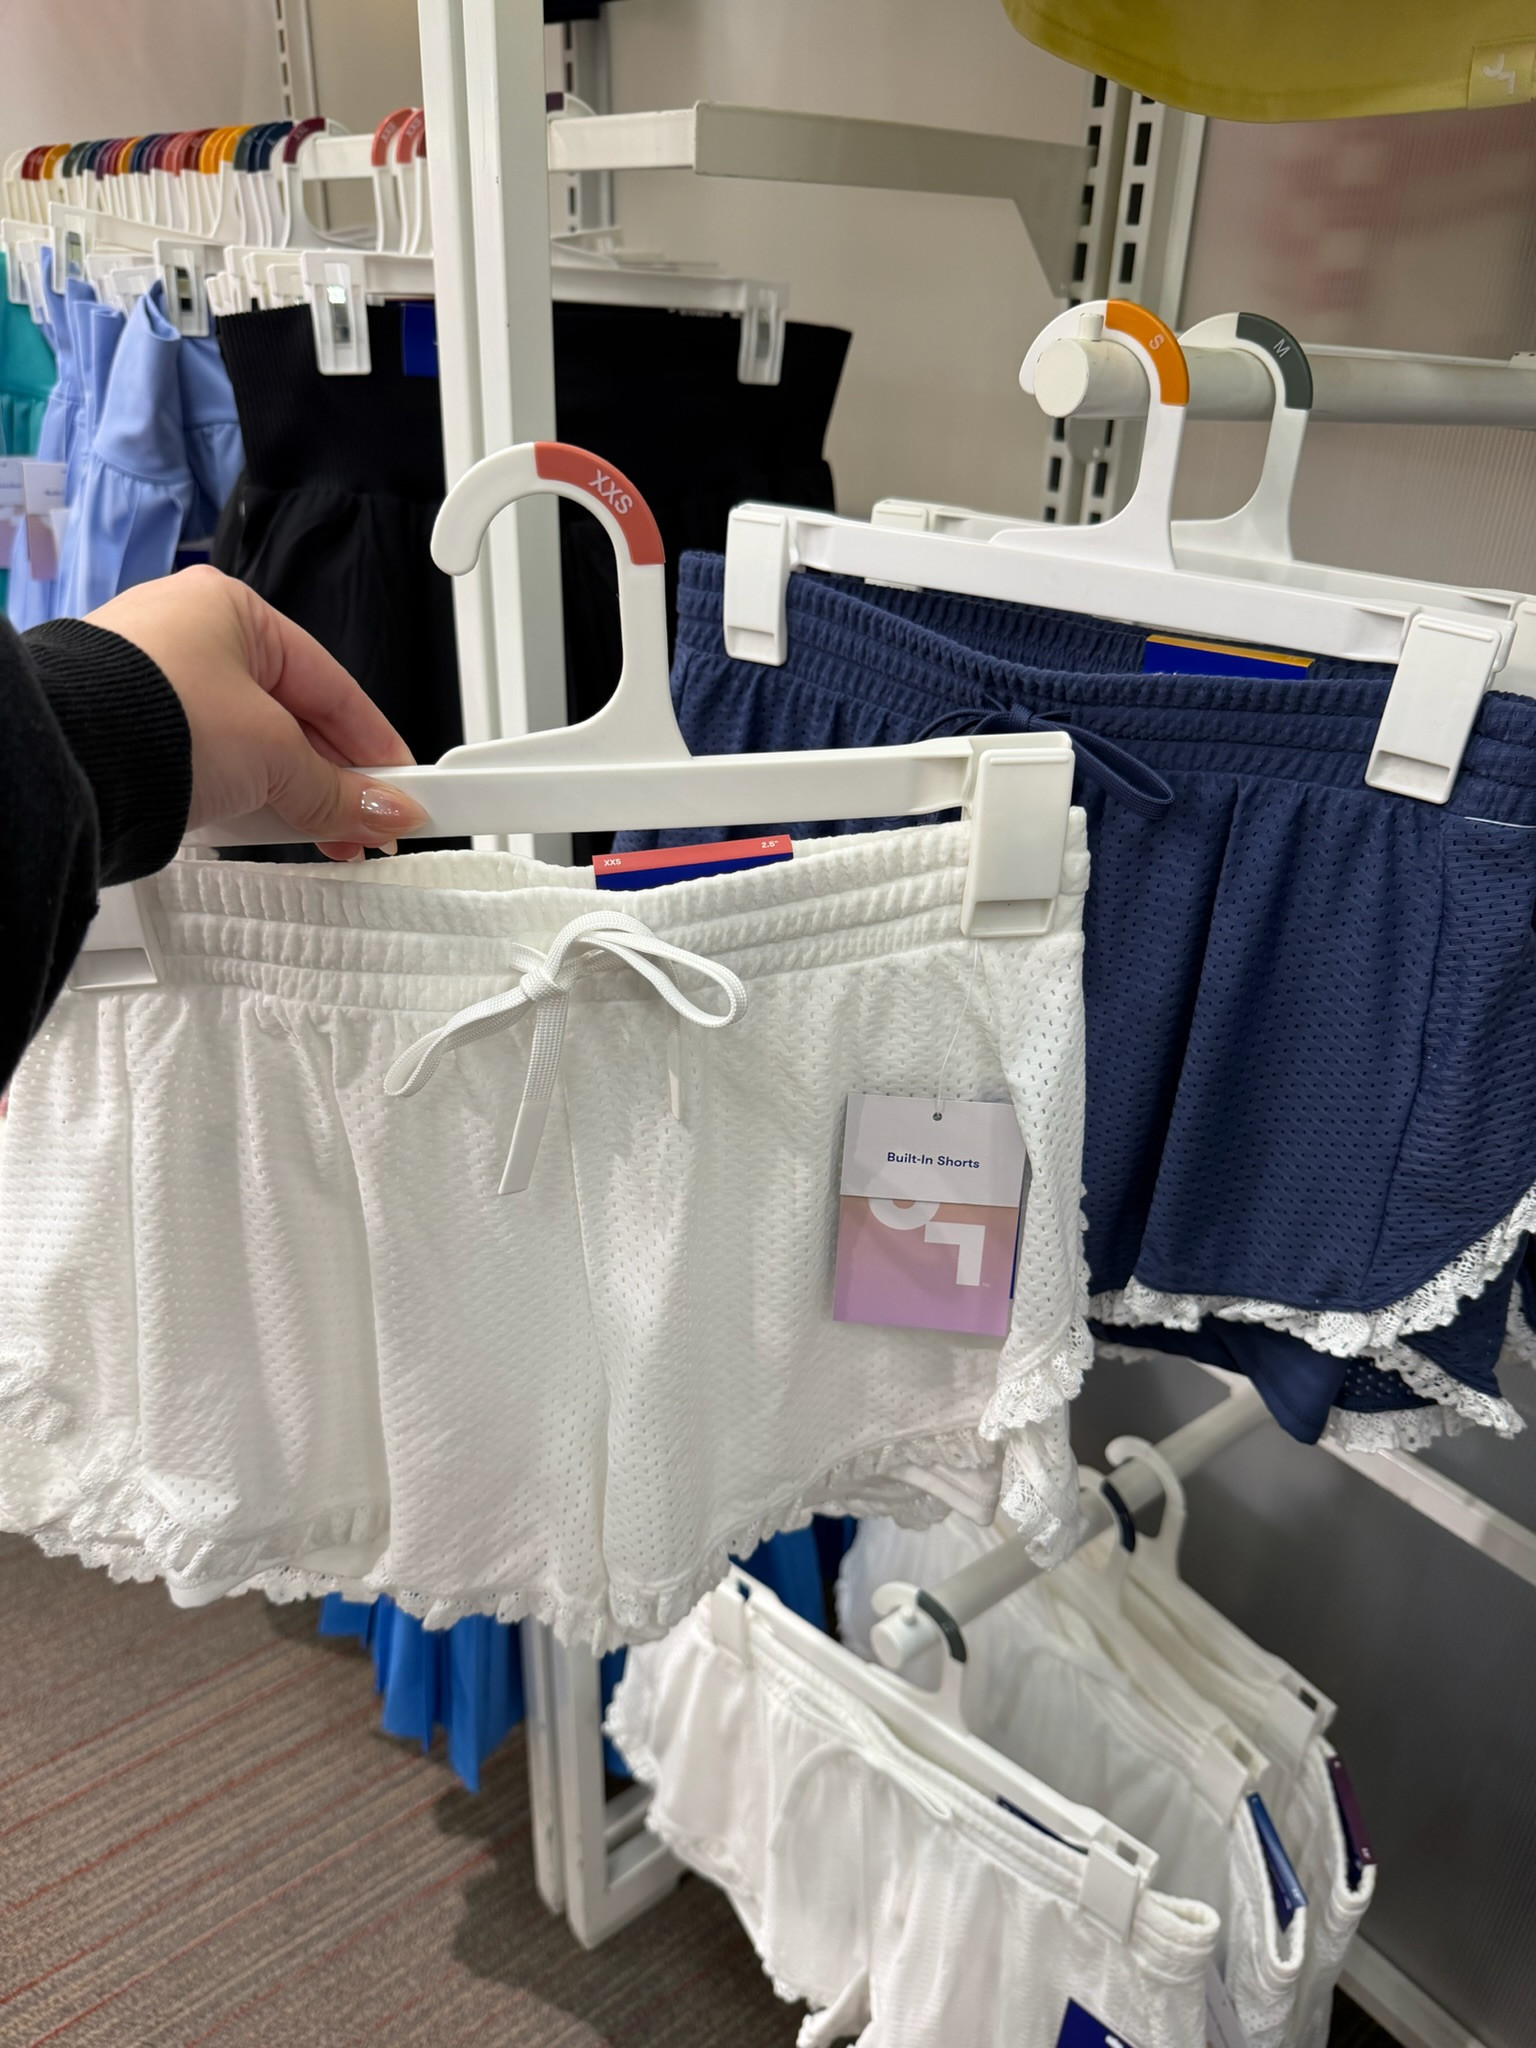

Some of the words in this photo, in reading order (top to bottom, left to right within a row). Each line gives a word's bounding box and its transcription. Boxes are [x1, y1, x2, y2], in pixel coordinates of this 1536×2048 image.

[1149, 333, 1166, 351] S
[1273, 339, 1291, 357] M
[587, 468, 633, 515] XXS
[604, 859, 621, 867] XXS
[886, 1151, 933, 1166] Built-In
[936, 1155, 981, 1169] Shorts
